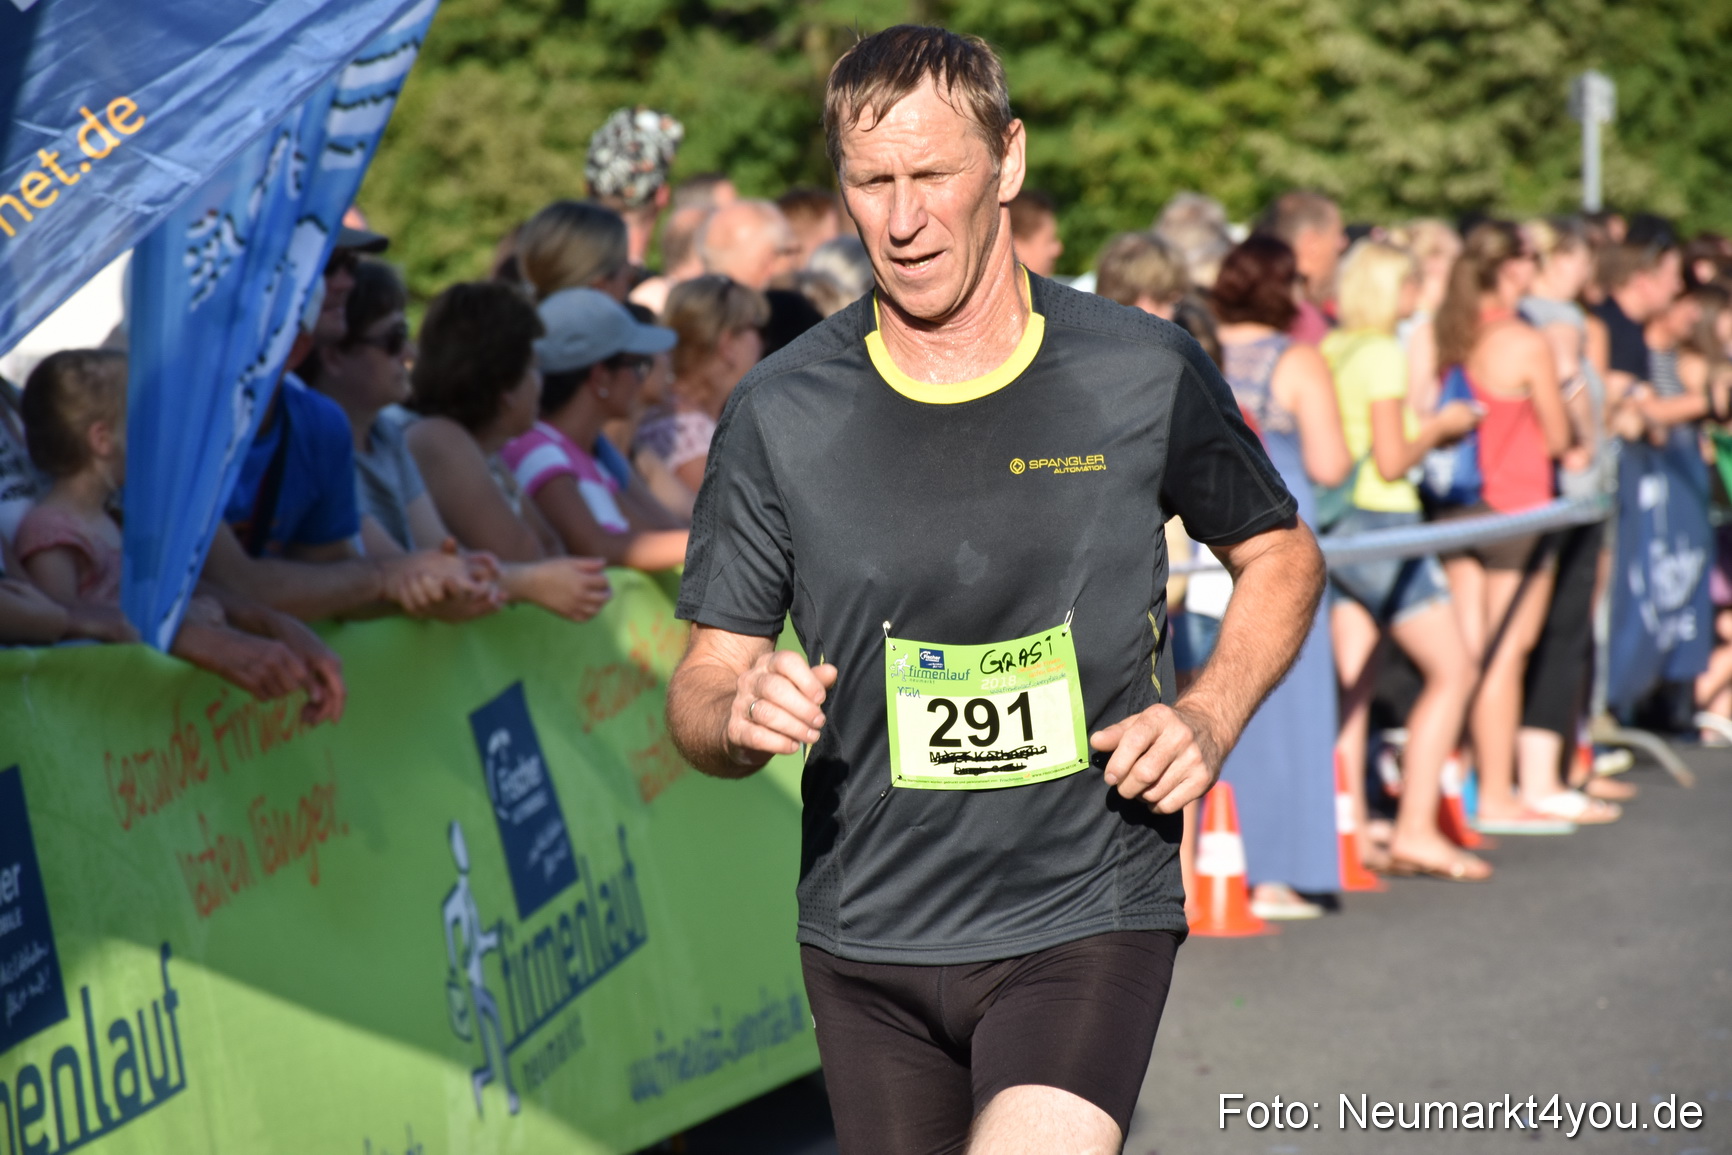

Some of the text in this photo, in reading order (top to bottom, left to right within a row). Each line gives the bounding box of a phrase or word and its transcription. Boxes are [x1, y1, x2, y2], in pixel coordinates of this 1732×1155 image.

[1029, 454, 1104, 469] SPANGLER
[1053, 464, 1106, 474] AUTOMATION
[909, 665, 971, 681] firmenlauf
[981, 675, 1017, 690] 2018
[926, 691, 1034, 748] 291
